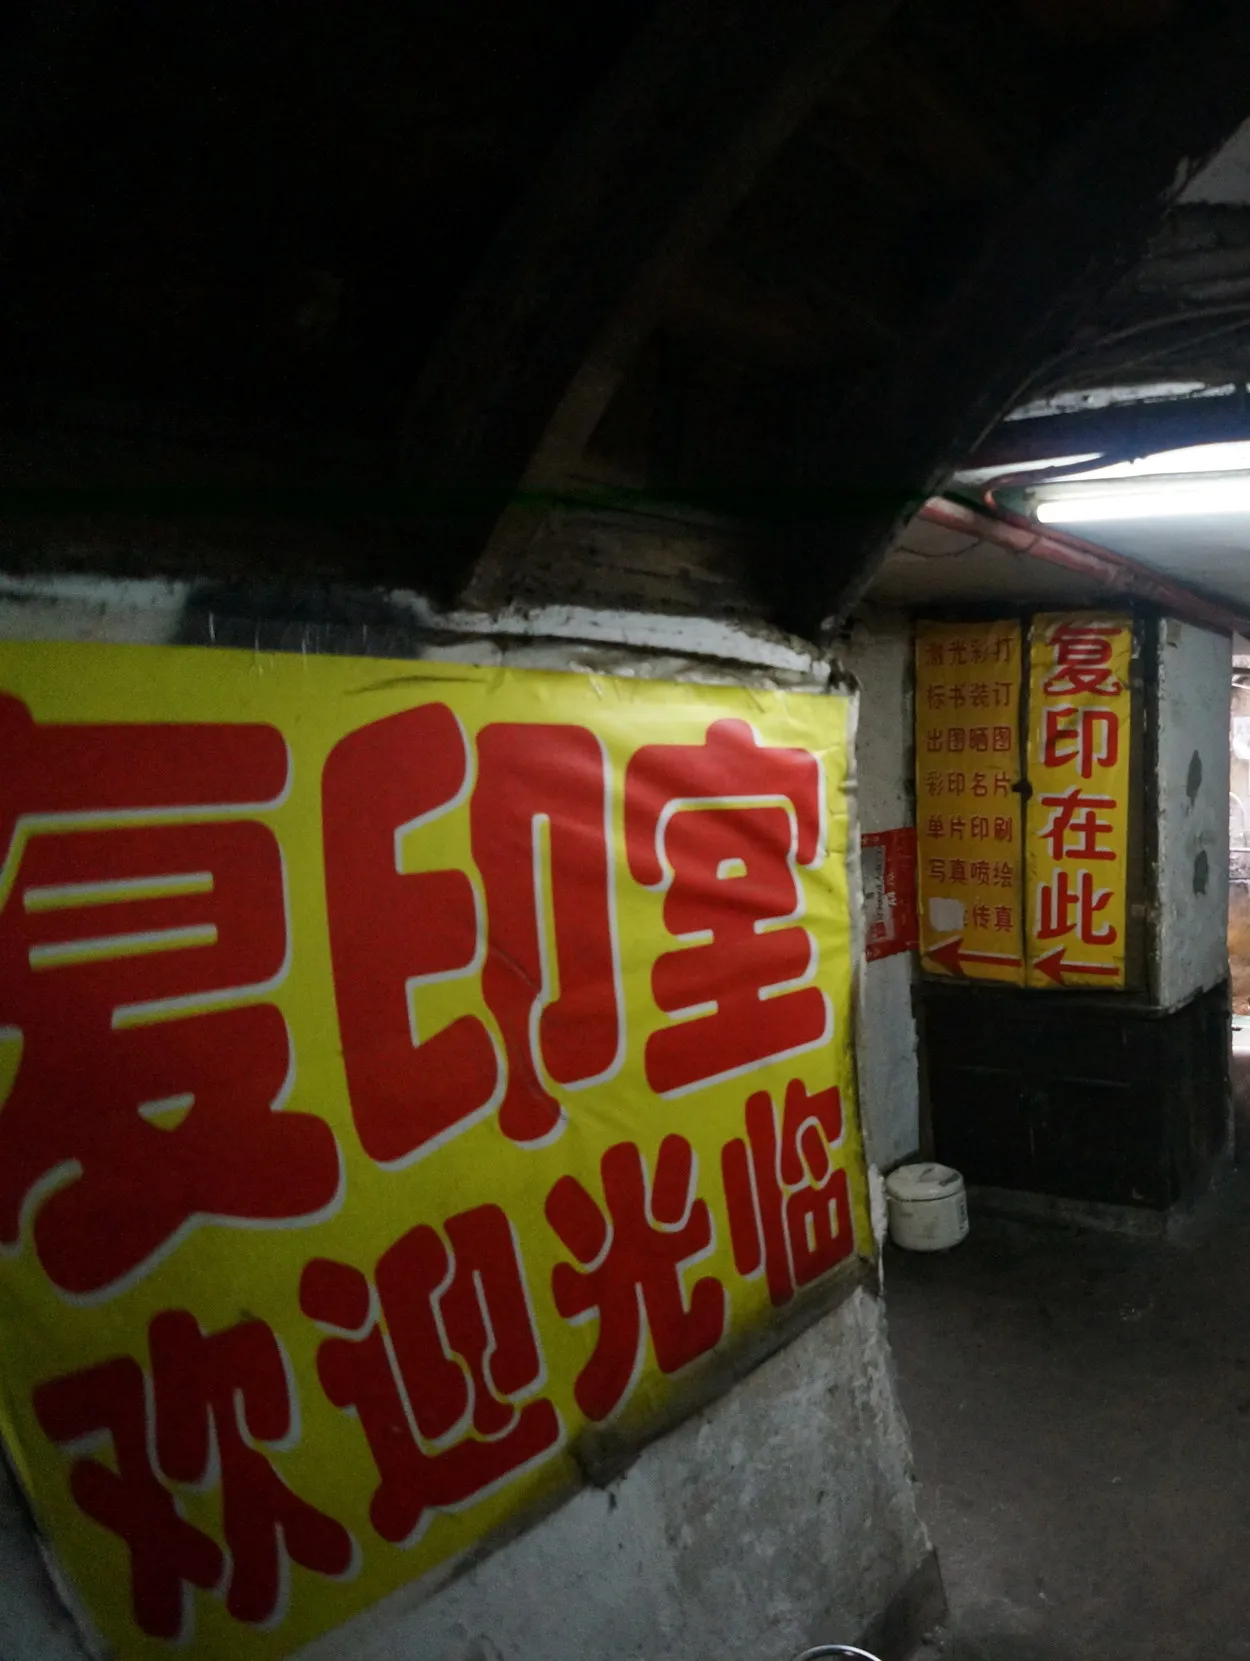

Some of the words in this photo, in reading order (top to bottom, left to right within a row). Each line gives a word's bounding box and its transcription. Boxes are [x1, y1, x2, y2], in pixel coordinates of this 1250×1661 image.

[927, 681, 1013, 709] 标书装订
[926, 725, 1012, 753] 出图晒图
[926, 770, 1012, 798] 彩印名片
[1037, 622, 1123, 946] 复印在此
[926, 814, 1014, 843] 单片印刷
[928, 858, 1014, 889] 写真喷绘
[0, 691, 832, 1306] 复印室
[33, 1077, 856, 1642] 欢迎光临
